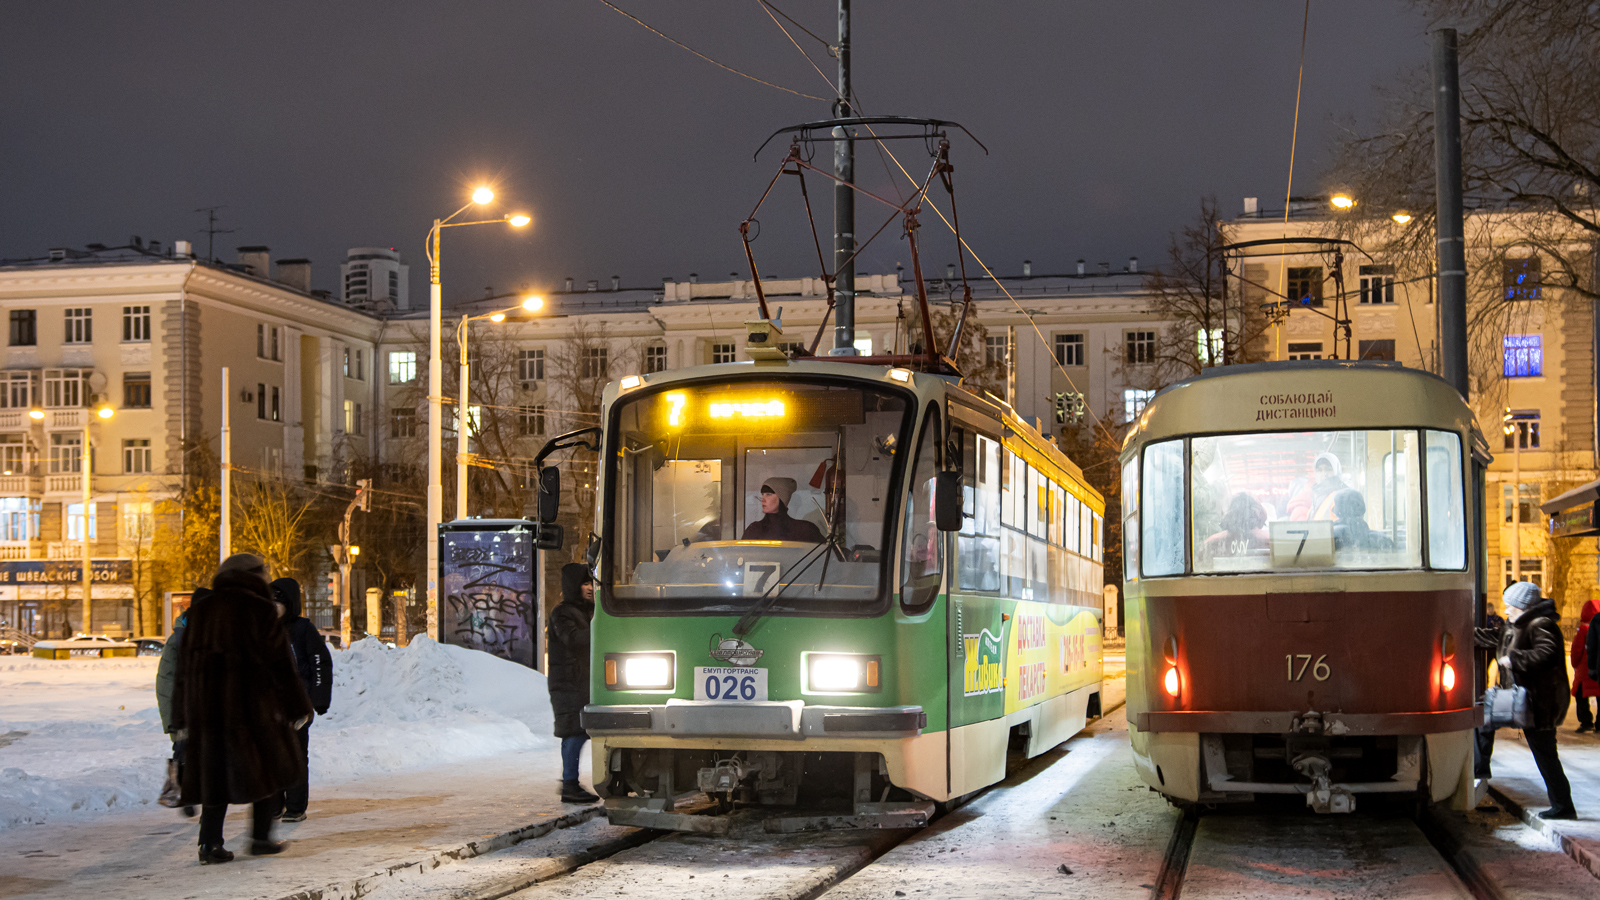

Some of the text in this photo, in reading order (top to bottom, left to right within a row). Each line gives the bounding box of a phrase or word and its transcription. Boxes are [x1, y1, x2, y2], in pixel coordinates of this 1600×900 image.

[666, 394, 685, 426] 7
[1286, 530, 1308, 565] 7
[16, 570, 78, 582] ШВЕДСКИЕ
[750, 565, 776, 592] 7
[1286, 654, 1330, 681] 176
[706, 675, 756, 700] 026
